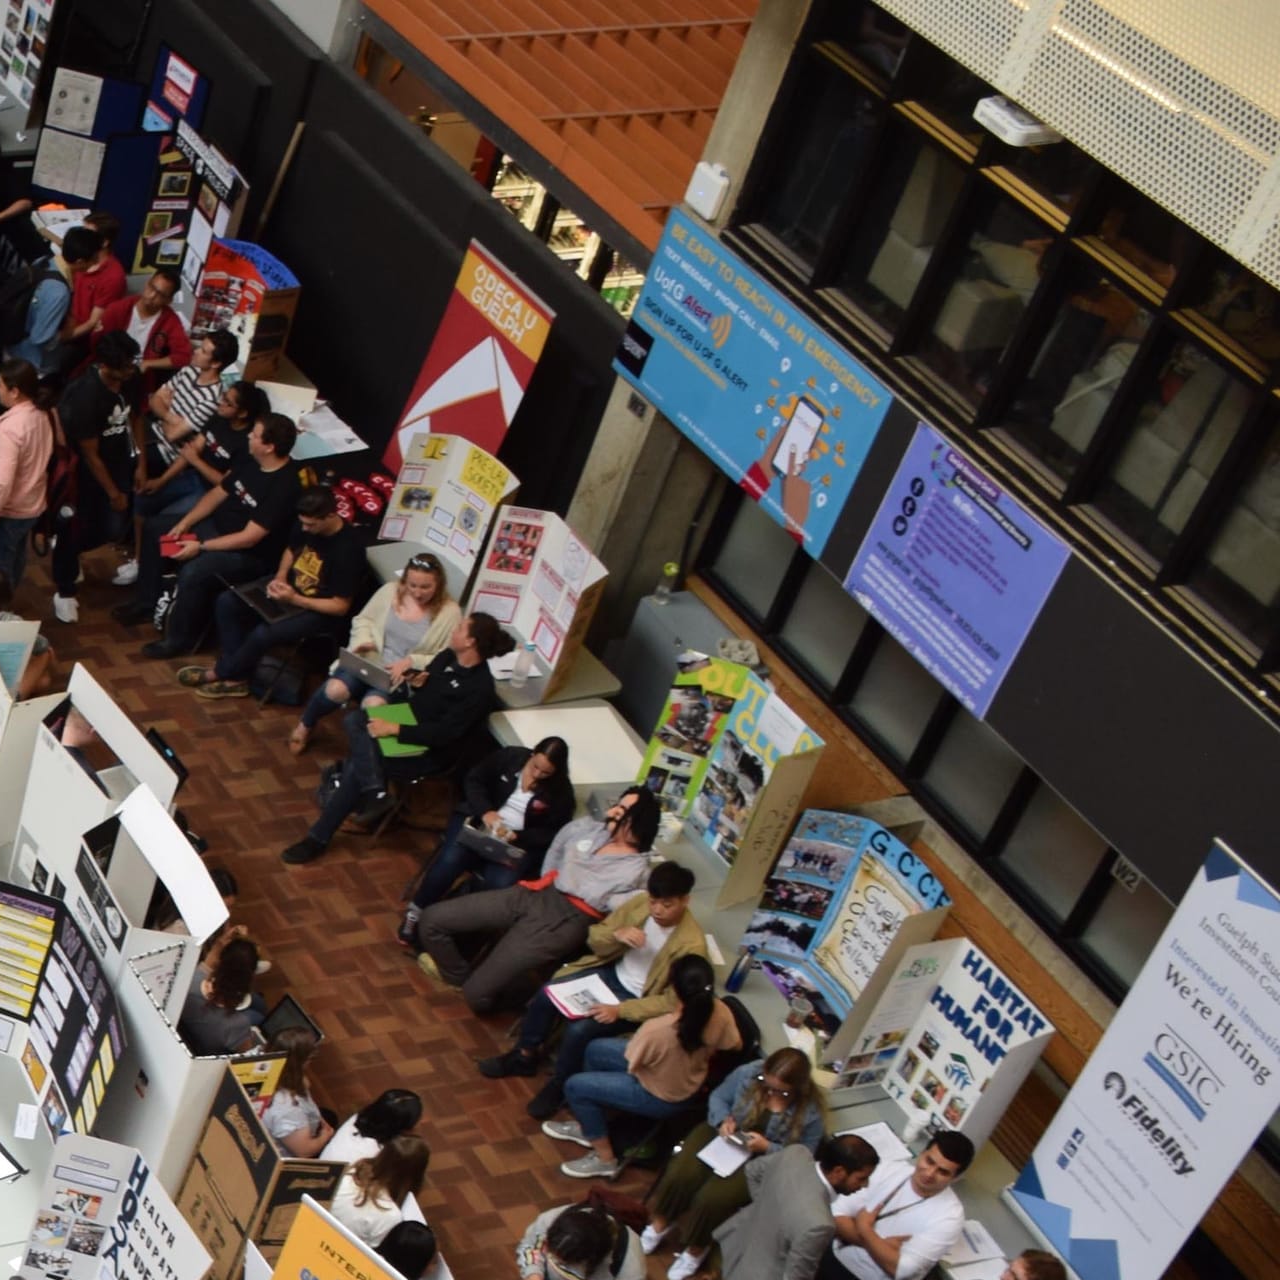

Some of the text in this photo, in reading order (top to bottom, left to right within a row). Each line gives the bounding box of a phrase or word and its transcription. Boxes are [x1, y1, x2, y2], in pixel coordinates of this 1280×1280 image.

[663, 245, 681, 265] TEXT
[470, 285, 526, 344] GUELPH
[670, 223, 687, 245] BE
[686, 236, 718, 268] EASY
[718, 262, 735, 283] TO
[733, 274, 775, 318] REACH
[773, 310, 788, 329] IN
[787, 323, 806, 345] AN
[804, 337, 882, 409] EMERGENCY
[682, 294, 714, 324] Alert
[676, 323, 695, 345] FOR
[721, 361, 749, 392] ALERT
[1113, 862, 1138, 889] W2
[1198, 915, 1258, 979] Investment
[1216, 911, 1260, 957] Guelph
[961, 948, 1047, 1038] HABITAT
[1170, 936, 1229, 999] Interested
[971, 993, 1014, 1045] FOR
[1164, 960, 1214, 1021] We're
[1212, 1012, 1273, 1087] Hiring
[1153, 1032, 1220, 1107] GSIC
[1121, 1094, 1196, 1178] Fidelity
